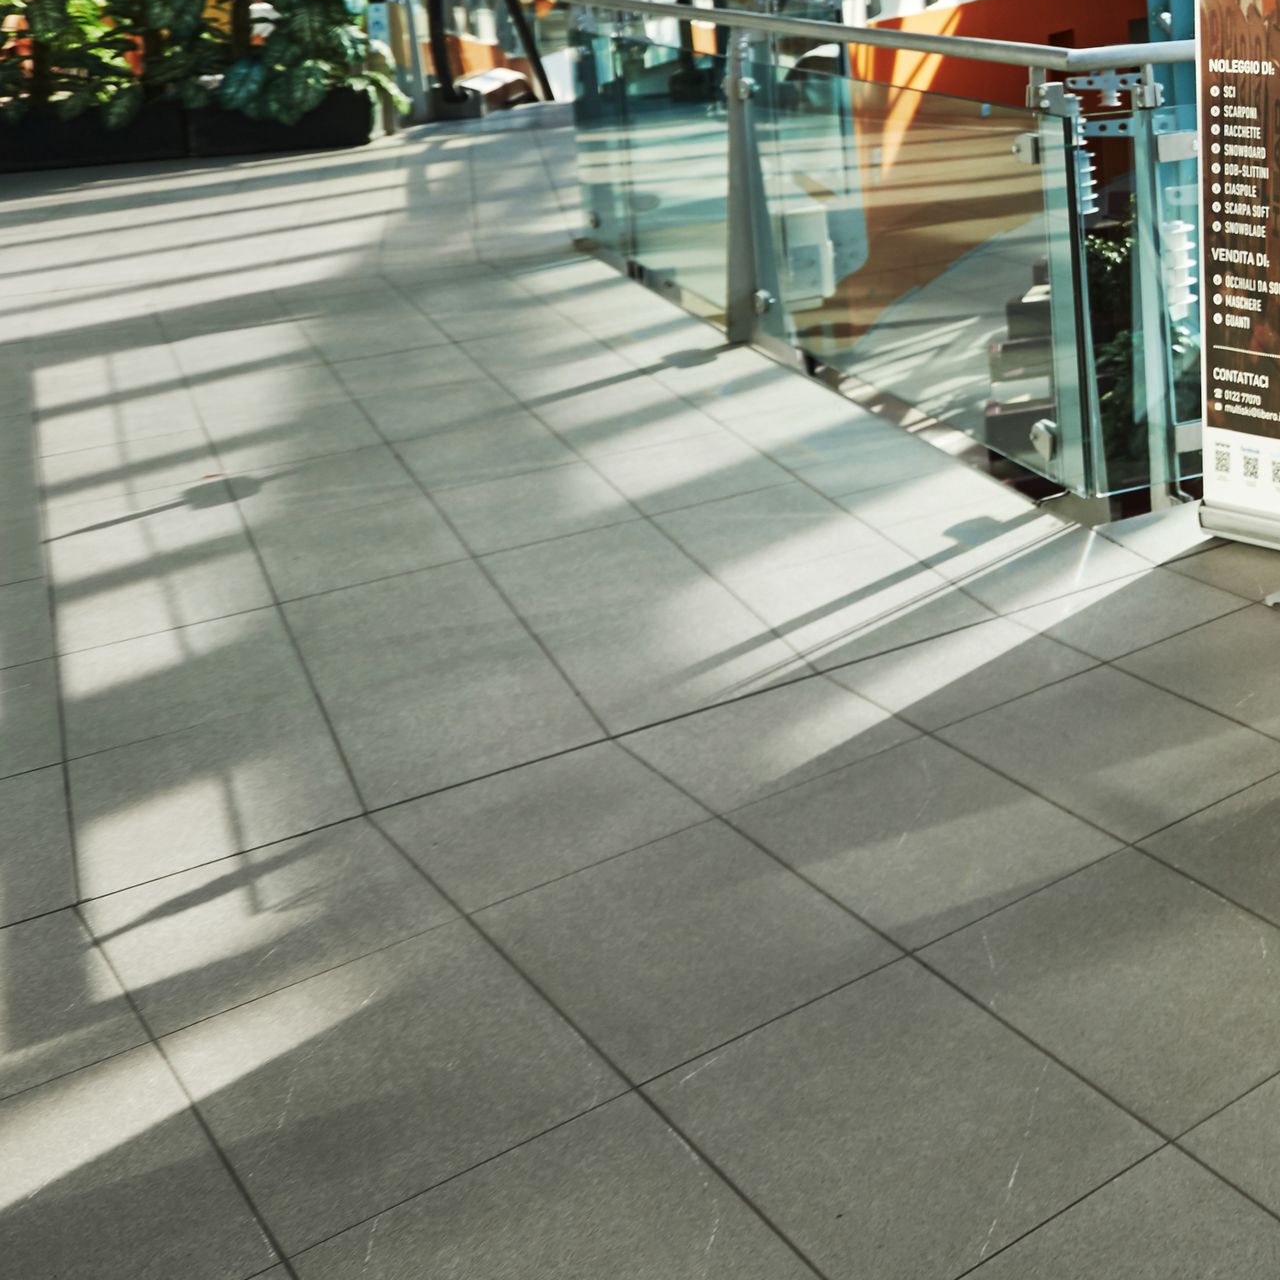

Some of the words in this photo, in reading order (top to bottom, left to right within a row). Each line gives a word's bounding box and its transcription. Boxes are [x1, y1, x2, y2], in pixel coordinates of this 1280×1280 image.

[1208, 58, 1260, 74] NOLEGGIO
[1261, 61, 1275, 75] DI:
[1223, 85, 1236, 98] SCI
[1223, 105, 1257, 119] SCARPONI
[1223, 124, 1261, 140] RACCHETTE
[1224, 143, 1266, 159] SNOWBOARD
[1224, 163, 1269, 179] BOB-SLITTINI
[1224, 182, 1257, 198] CIASPOLE
[1224, 201, 1251, 216] SCARPA
[1252, 205, 1270, 218] SOFT
[1224, 221, 1266, 238] SNOWBLADE
[1211, 247, 1255, 266] VENDITA
[1256, 253, 1270, 268] DI:
[1225, 274, 1256, 291] OCCHIALI
[1257, 280, 1268, 293] DA
[1225, 295, 1262, 312] MASCHERE
[1225, 313, 1250, 330] GUANTI
[1213, 367, 1269, 389] CONTATTACI
[1224, 389, 1240, 402] 0122
